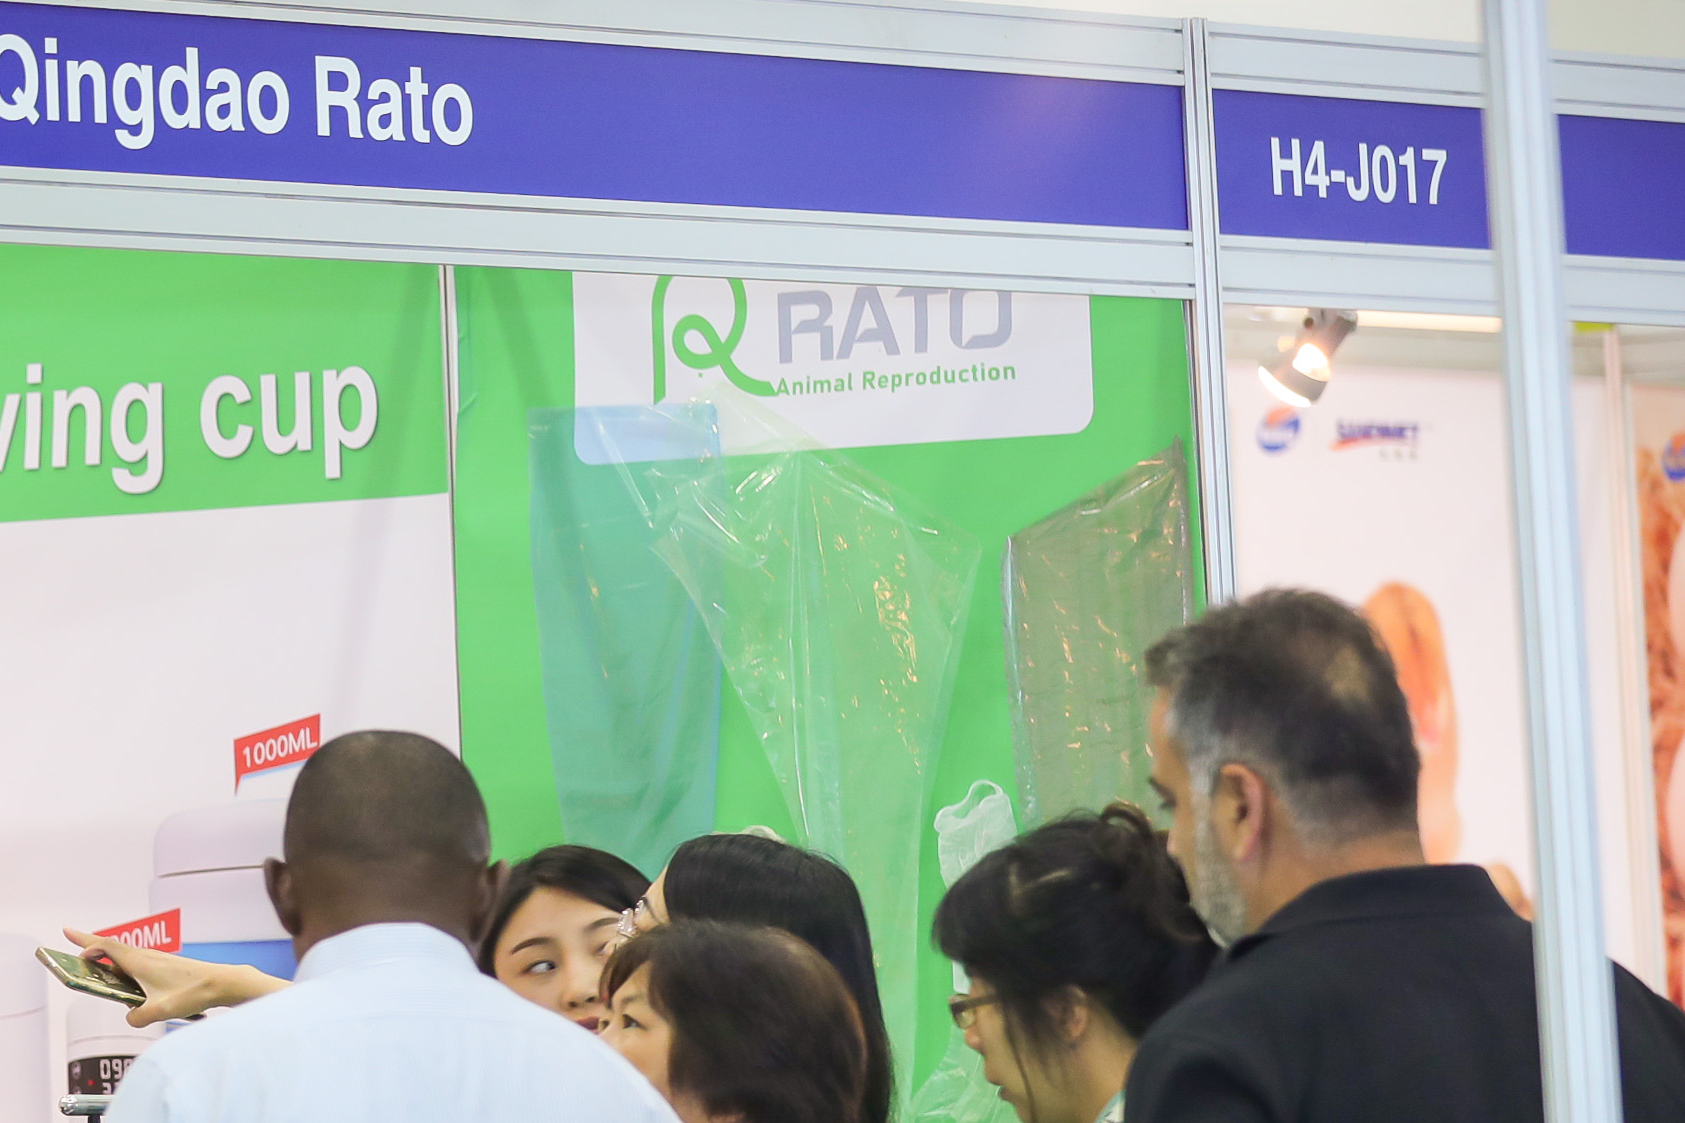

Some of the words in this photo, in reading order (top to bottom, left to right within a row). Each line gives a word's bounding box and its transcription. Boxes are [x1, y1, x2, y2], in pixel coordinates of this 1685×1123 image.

[315, 55, 474, 146] Rato
[1270, 136, 1448, 206] H4-J017
[776, 285, 1013, 364] RATO
[775, 369, 853, 397] Animal
[862, 362, 1017, 393] Reproduction
[200, 365, 379, 480] cup
[242, 726, 318, 768] 1000ML
[111, 920, 172, 949] 00ML
